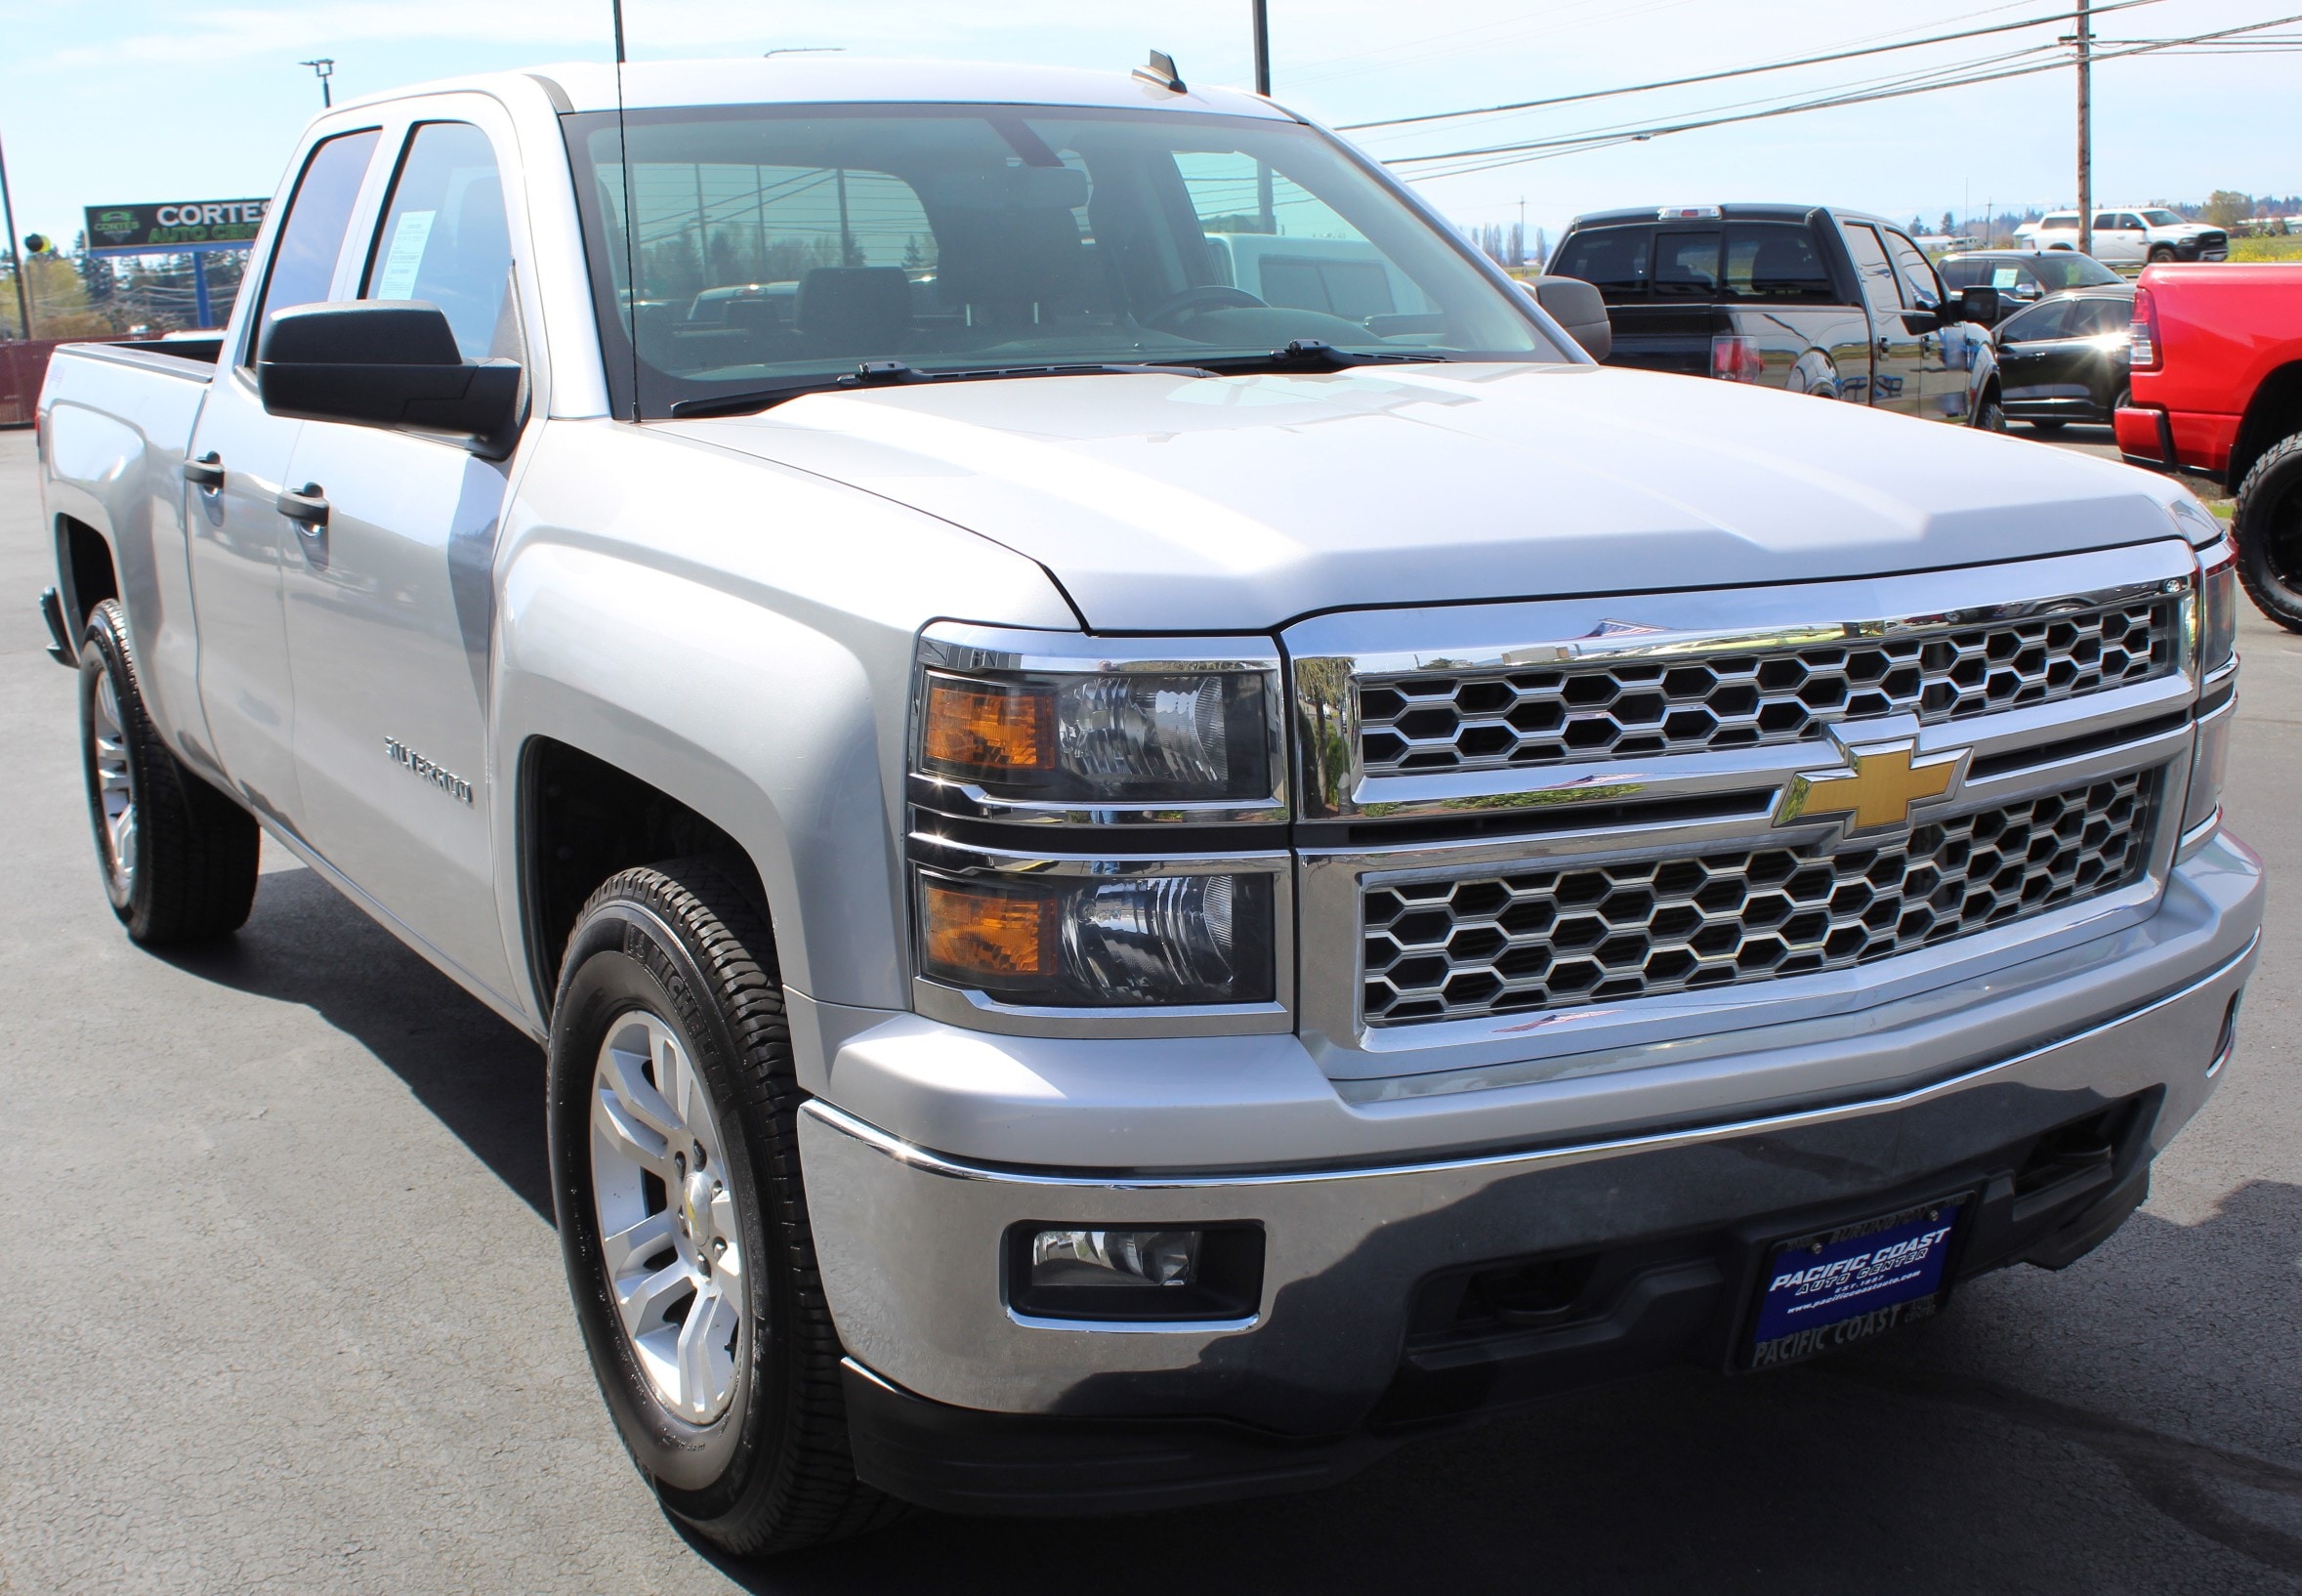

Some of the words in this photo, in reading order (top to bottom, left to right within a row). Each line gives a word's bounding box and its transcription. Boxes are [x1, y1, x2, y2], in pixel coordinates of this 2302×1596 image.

[147, 226, 207, 243] AUTO
[385, 735, 474, 803] SILVERADO
[1769, 1253, 1871, 1291] PACIFIC
[1872, 1227, 1951, 1263] COAST
[1795, 1273, 1851, 1296] AUTO
[1856, 1247, 1930, 1280] CENTER
[1786, 1270, 1922, 1314] www.pacificcoastauto.com
[1751, 1323, 1830, 1368] PACIFIC
[1833, 1305, 1903, 1345] COAST
